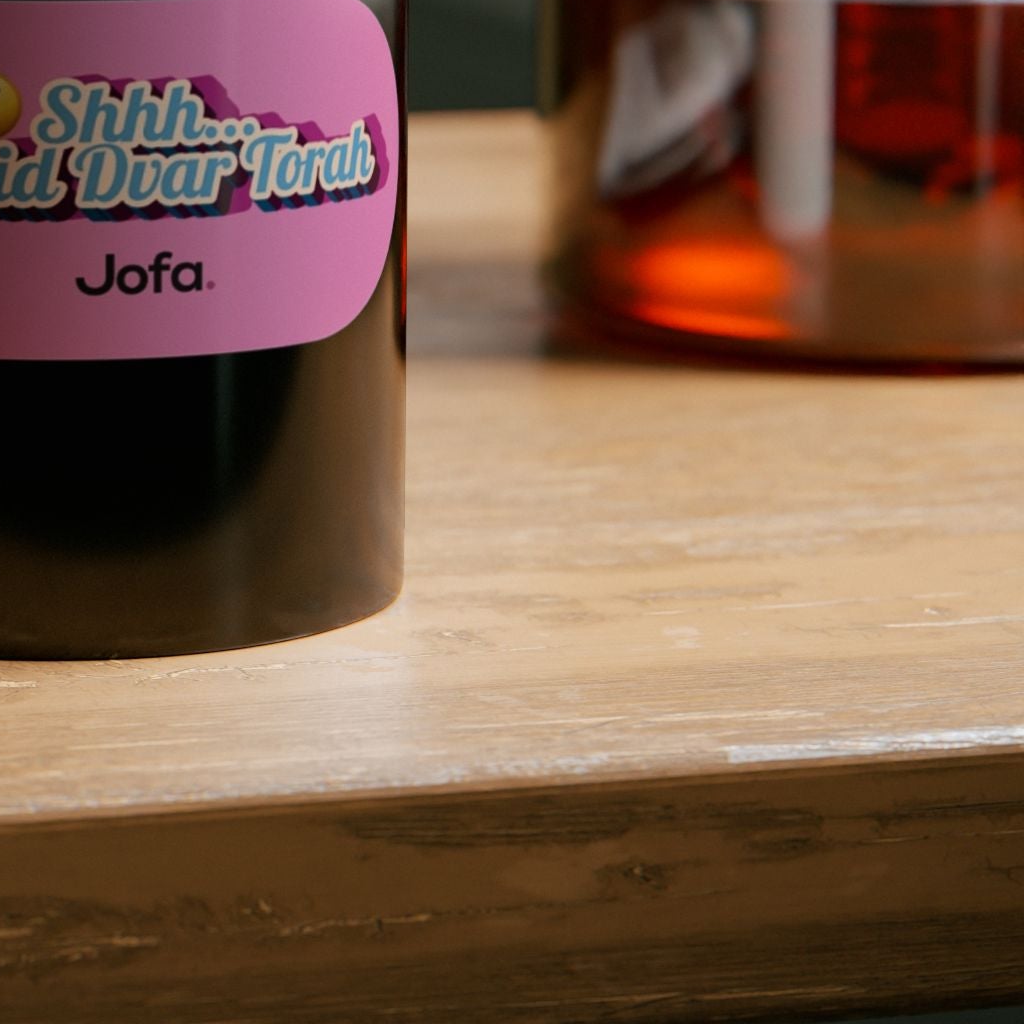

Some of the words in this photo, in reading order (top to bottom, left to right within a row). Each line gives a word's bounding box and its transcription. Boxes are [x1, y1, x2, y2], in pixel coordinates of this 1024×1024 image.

[31, 78, 258, 148] Shhh...
[69, 143, 237, 208] Dvar
[239, 117, 375, 200] Torah
